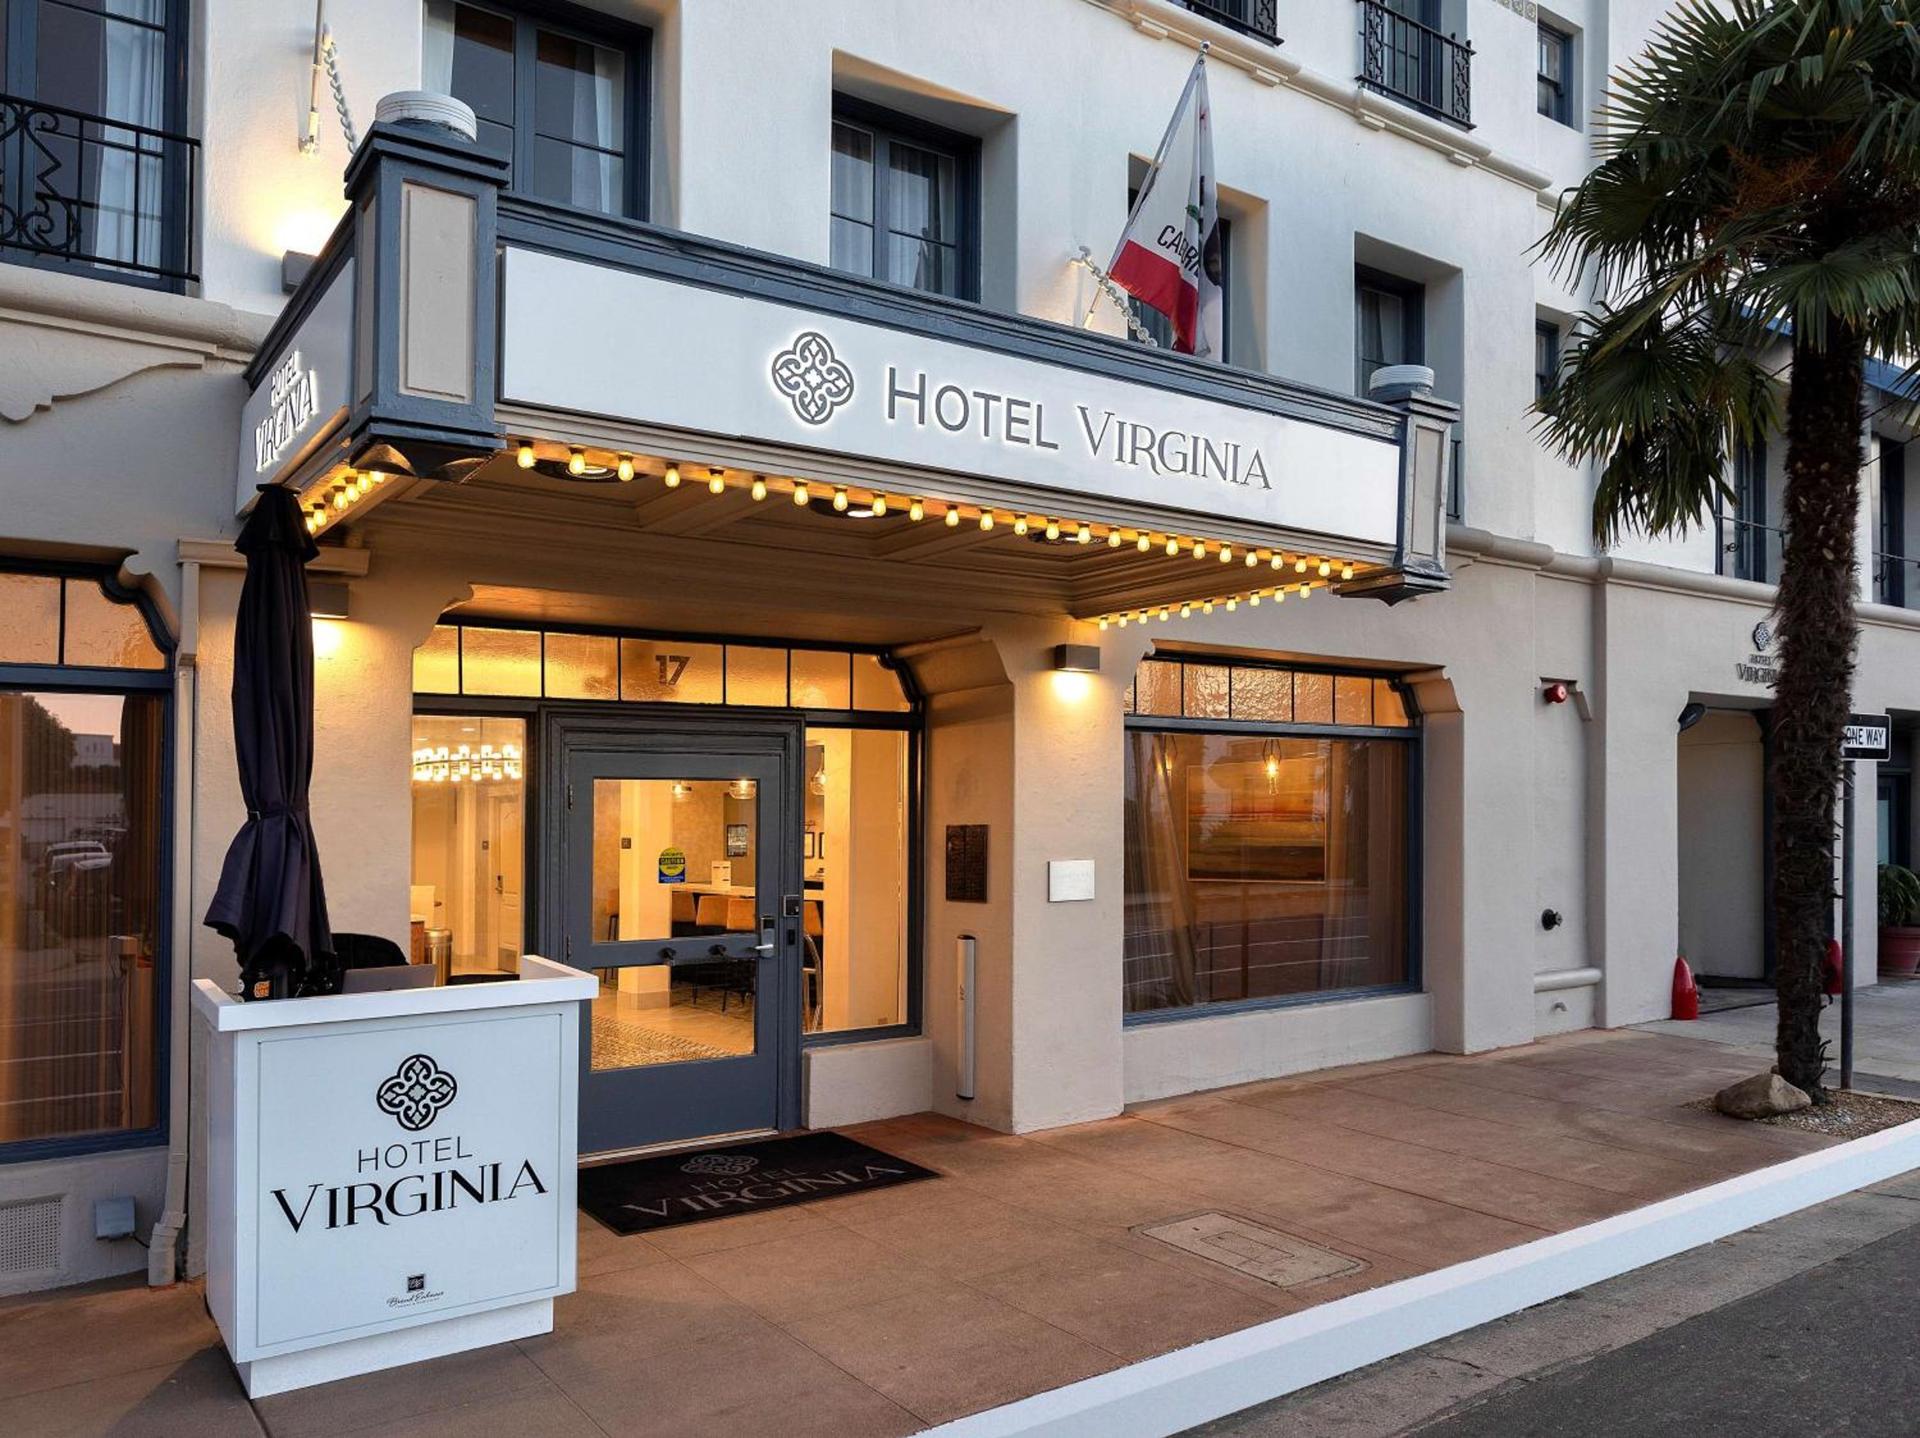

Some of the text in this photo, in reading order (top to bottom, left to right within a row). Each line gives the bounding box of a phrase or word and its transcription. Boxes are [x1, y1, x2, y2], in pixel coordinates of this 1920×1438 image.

[271, 351, 300, 406] HOTEL
[256, 369, 316, 472] VIRGINIA
[887, 366, 1272, 491] HOTEL VIRGINIA
[655, 655, 691, 686] 17
[1846, 727, 1884, 746] ONE WAY
[358, 1135, 473, 1173] HOTEL
[692, 1167, 807, 1193] HOTEL
[270, 1159, 549, 1234] VIRGINIA
[622, 1164, 906, 1218] VIRGINIA
